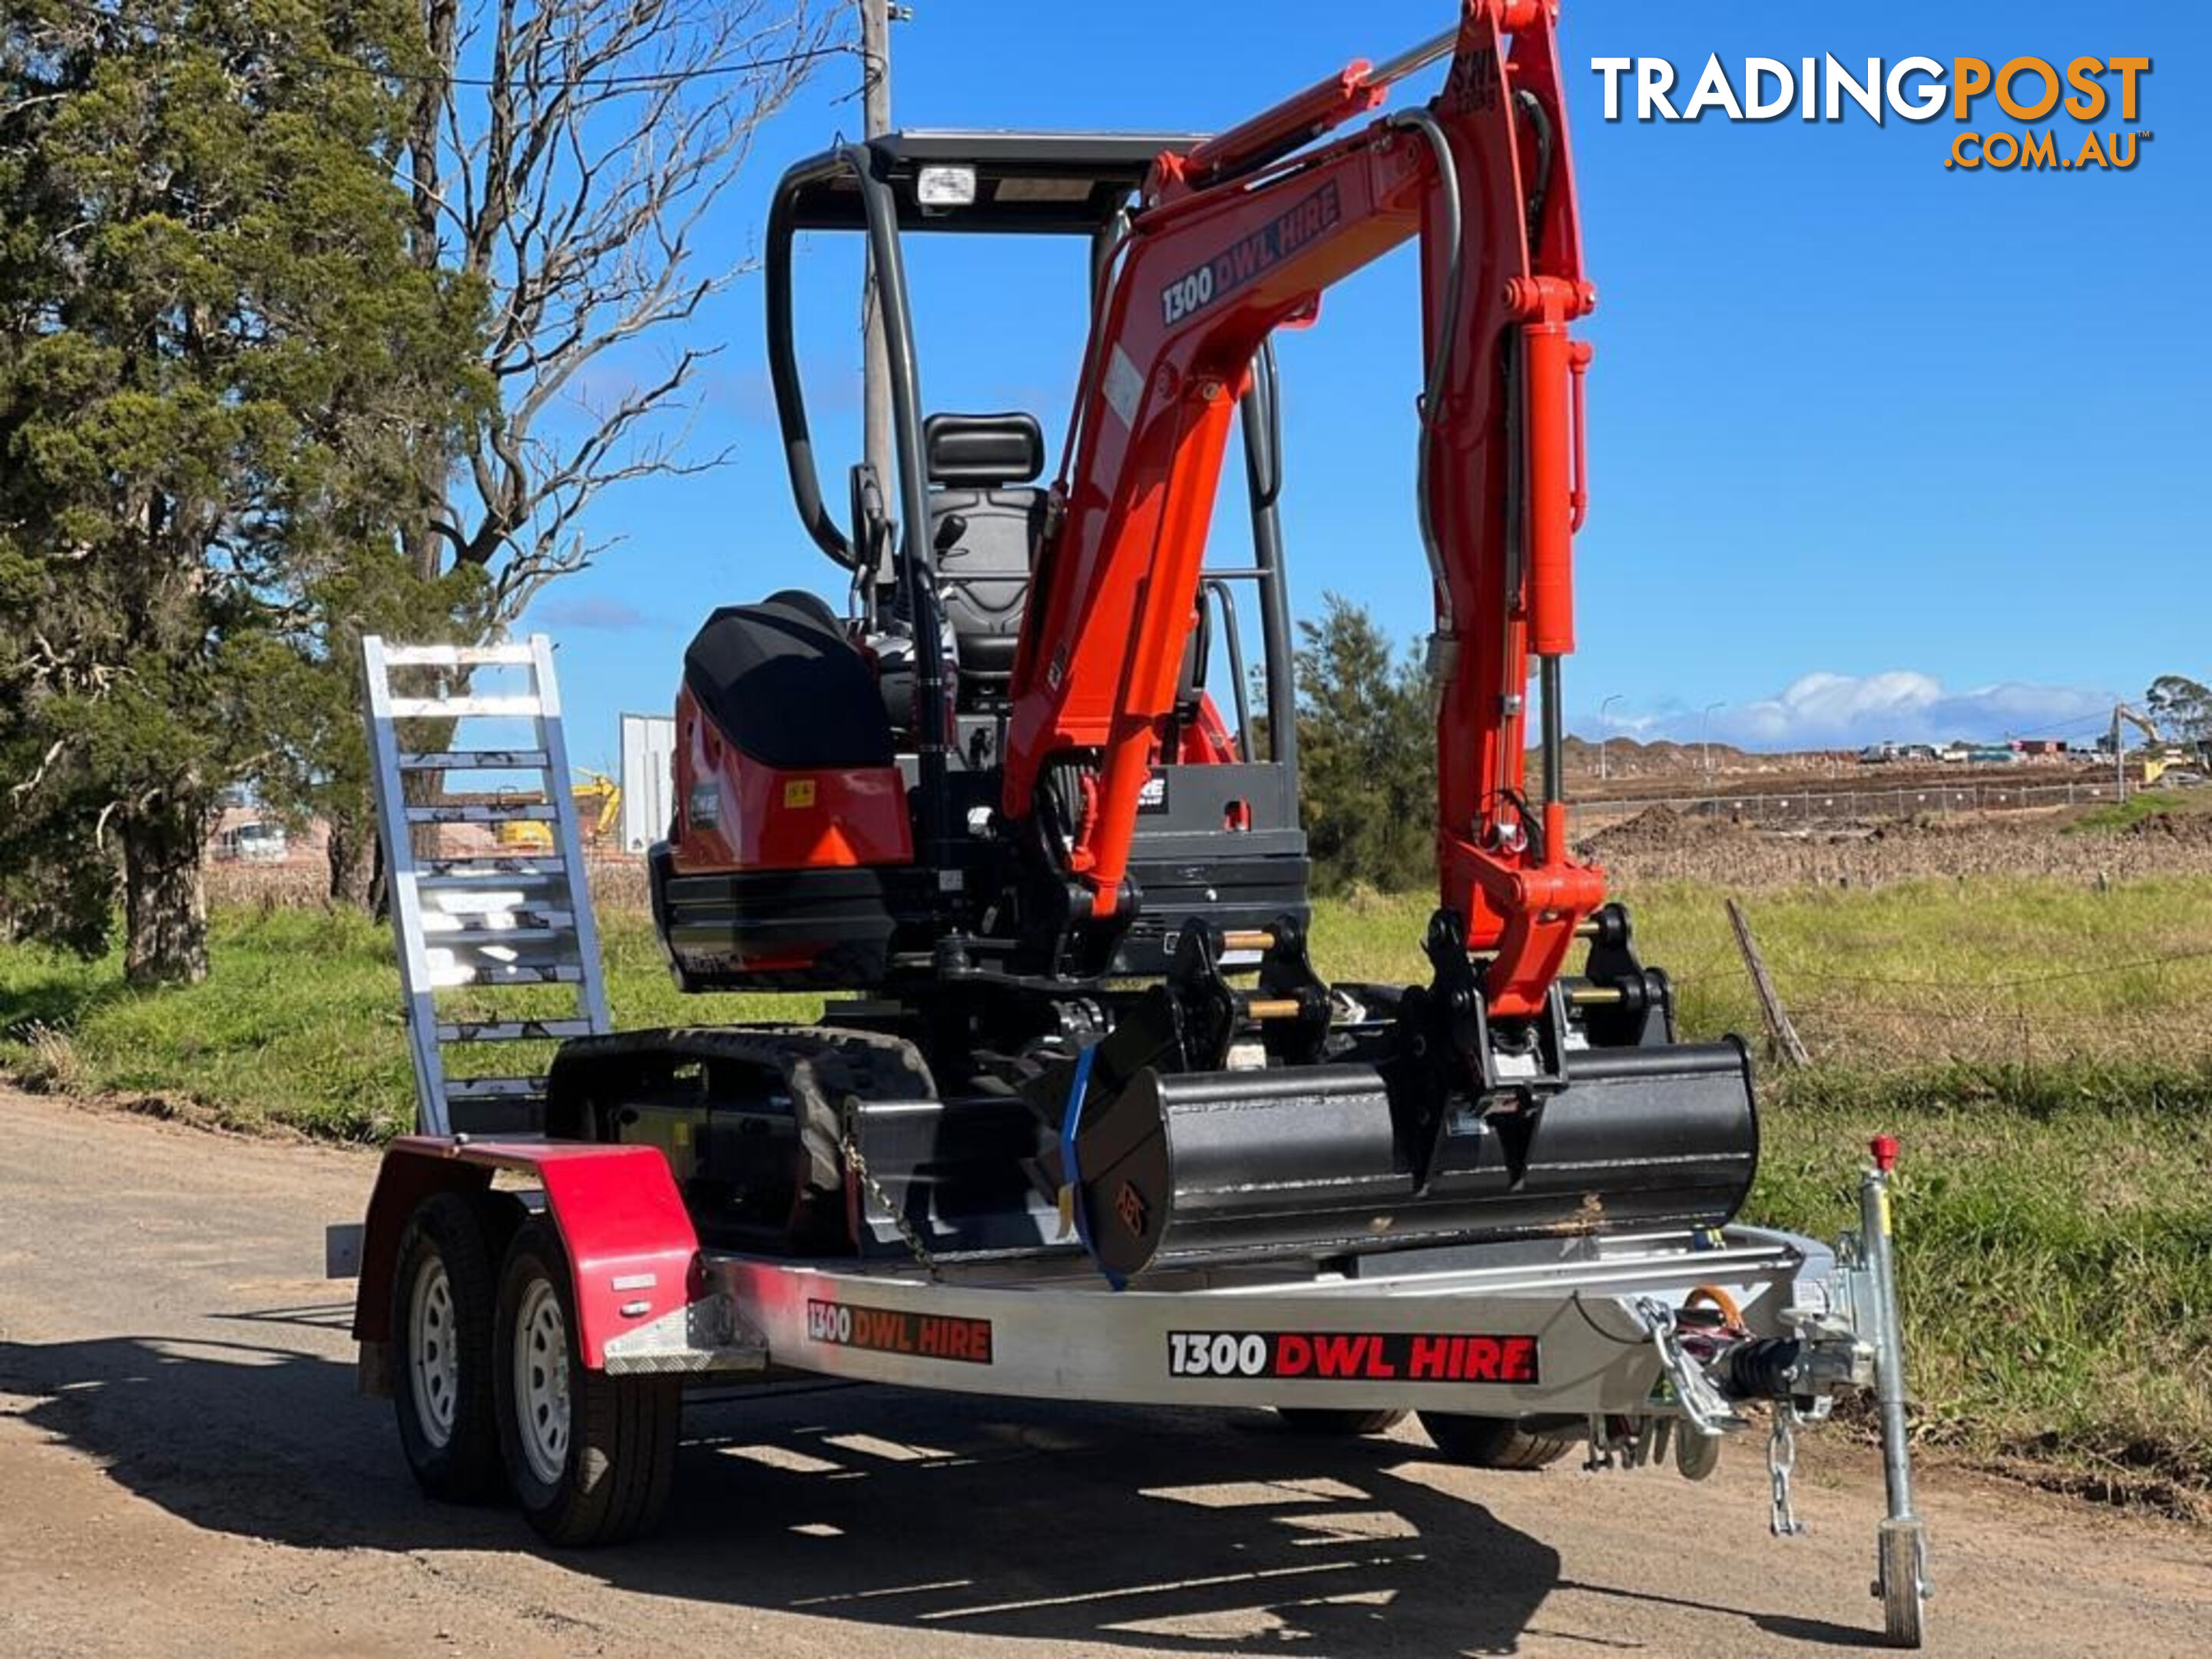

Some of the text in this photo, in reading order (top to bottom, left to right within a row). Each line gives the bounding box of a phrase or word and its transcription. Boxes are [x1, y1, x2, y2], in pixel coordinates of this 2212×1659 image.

[1163, 184, 1336, 324] 1300 DWL HIRE
[809, 1303, 988, 1359] 1300 DWL HIRE
[1171, 1333, 1534, 1380] 1300 DWL HIRE
